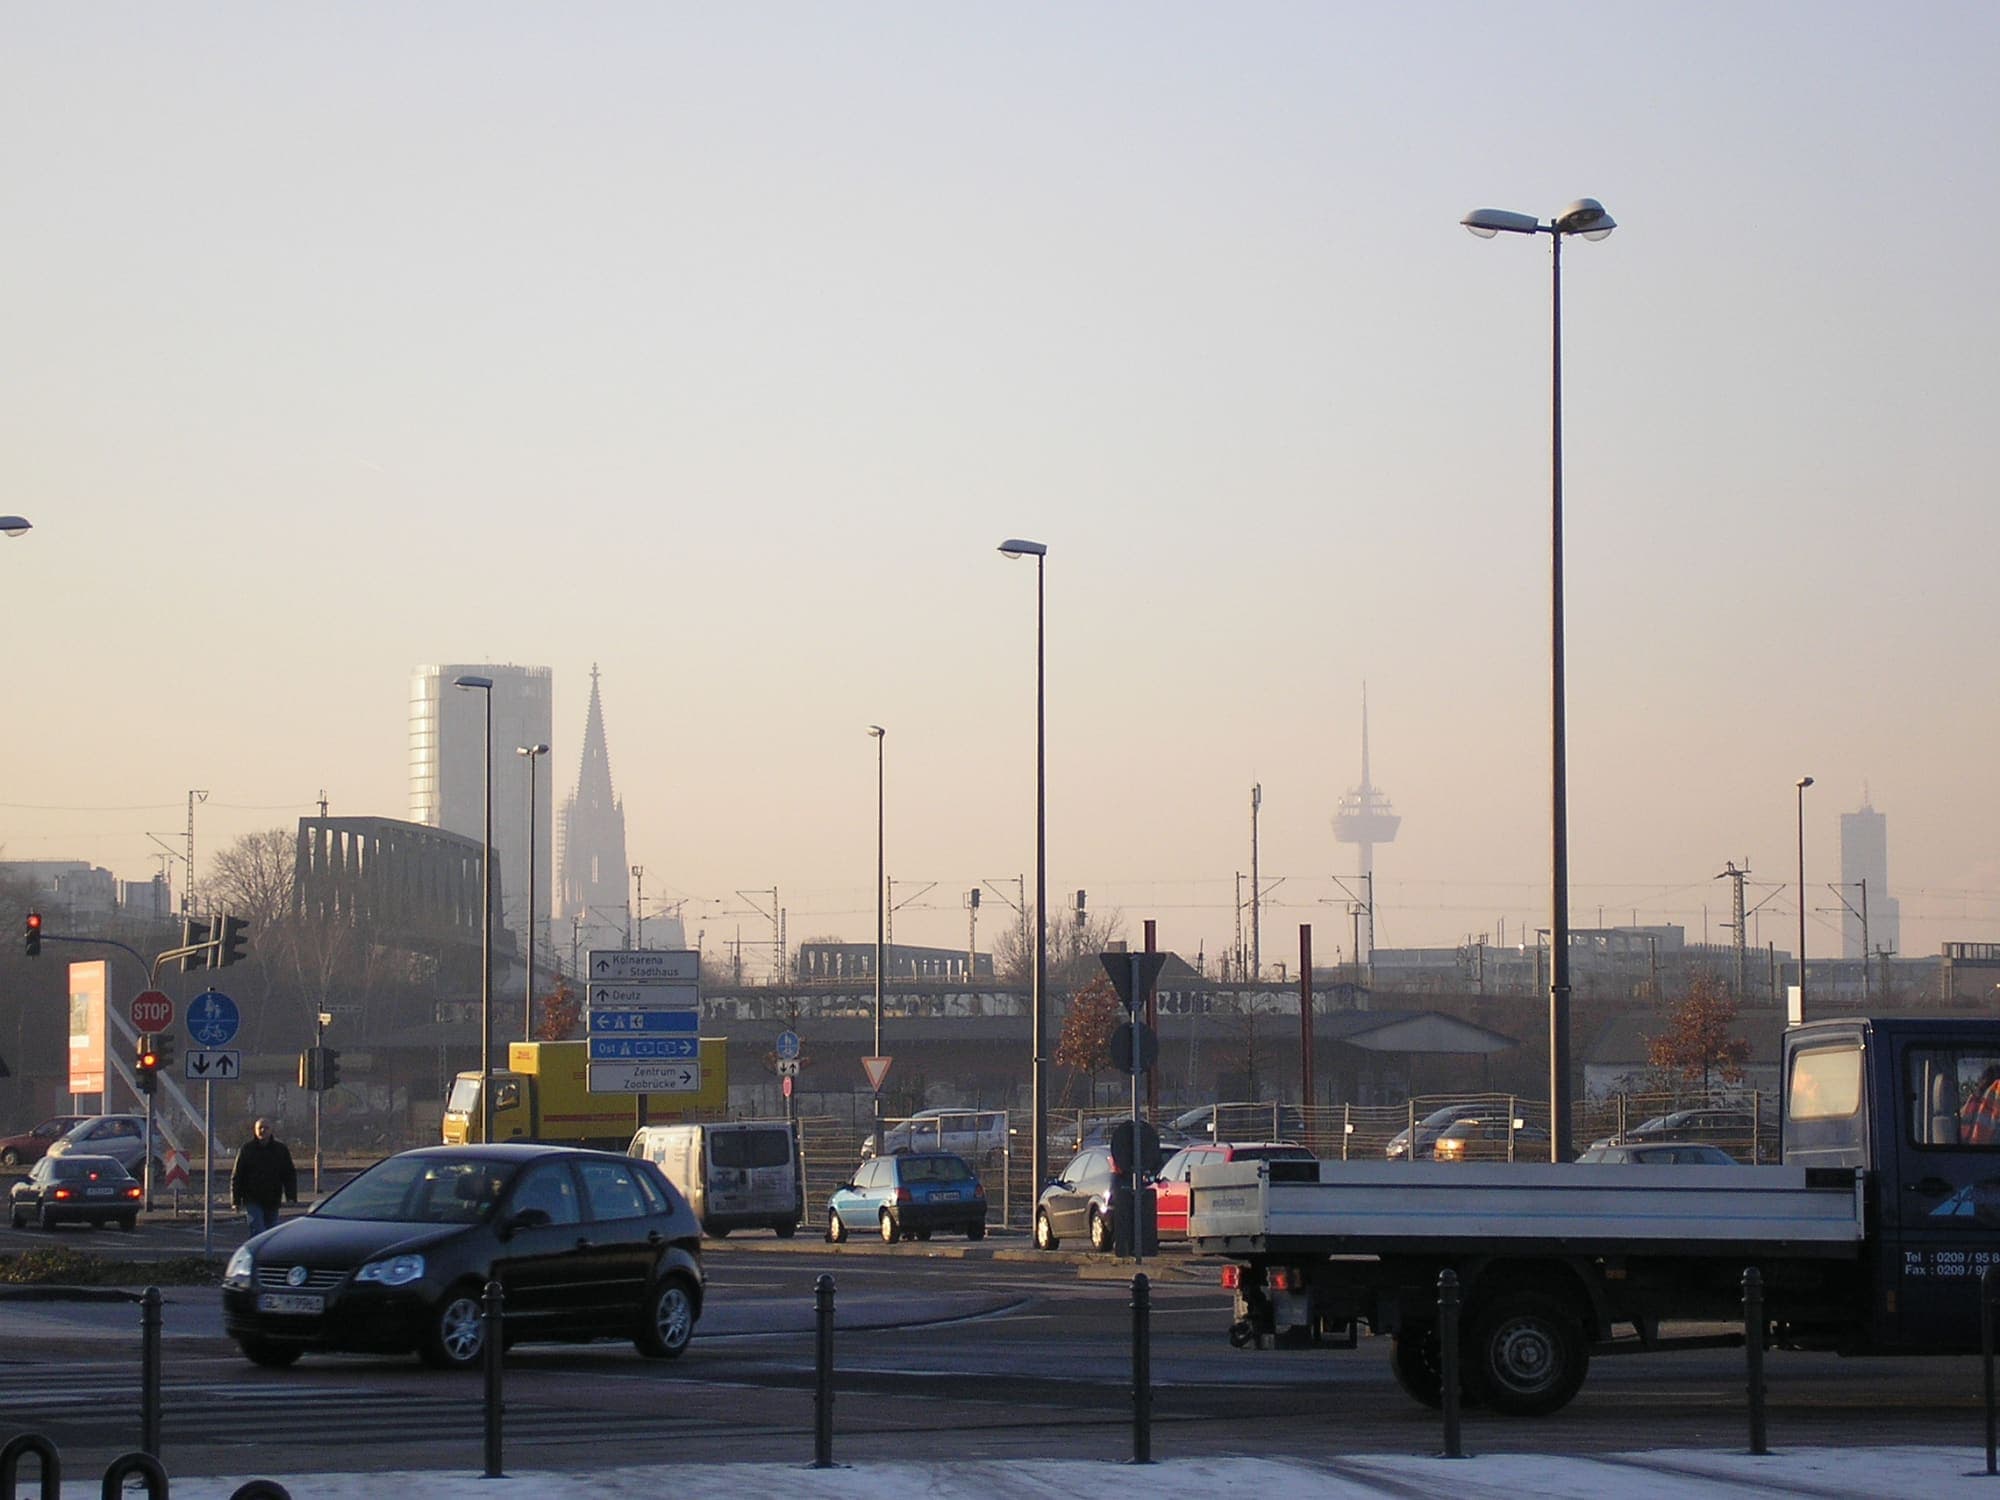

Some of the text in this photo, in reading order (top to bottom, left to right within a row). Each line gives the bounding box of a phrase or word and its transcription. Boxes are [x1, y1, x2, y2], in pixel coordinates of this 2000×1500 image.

[630, 967, 679, 977] Stadthaus
[612, 991, 640, 1001] Deutz
[134, 1003, 169, 1020] STOP
[633, 1067, 676, 1076] Zentrum
[624, 1079, 676, 1089] Zoobrücke
[1904, 1252, 1921, 1262] Tel
[1937, 1252, 1965, 1263] 0209
[1975, 1252, 1990, 1263] 95
[1904, 1264, 1926, 1275] Fax
[1937, 1265, 1965, 1276] 0209
